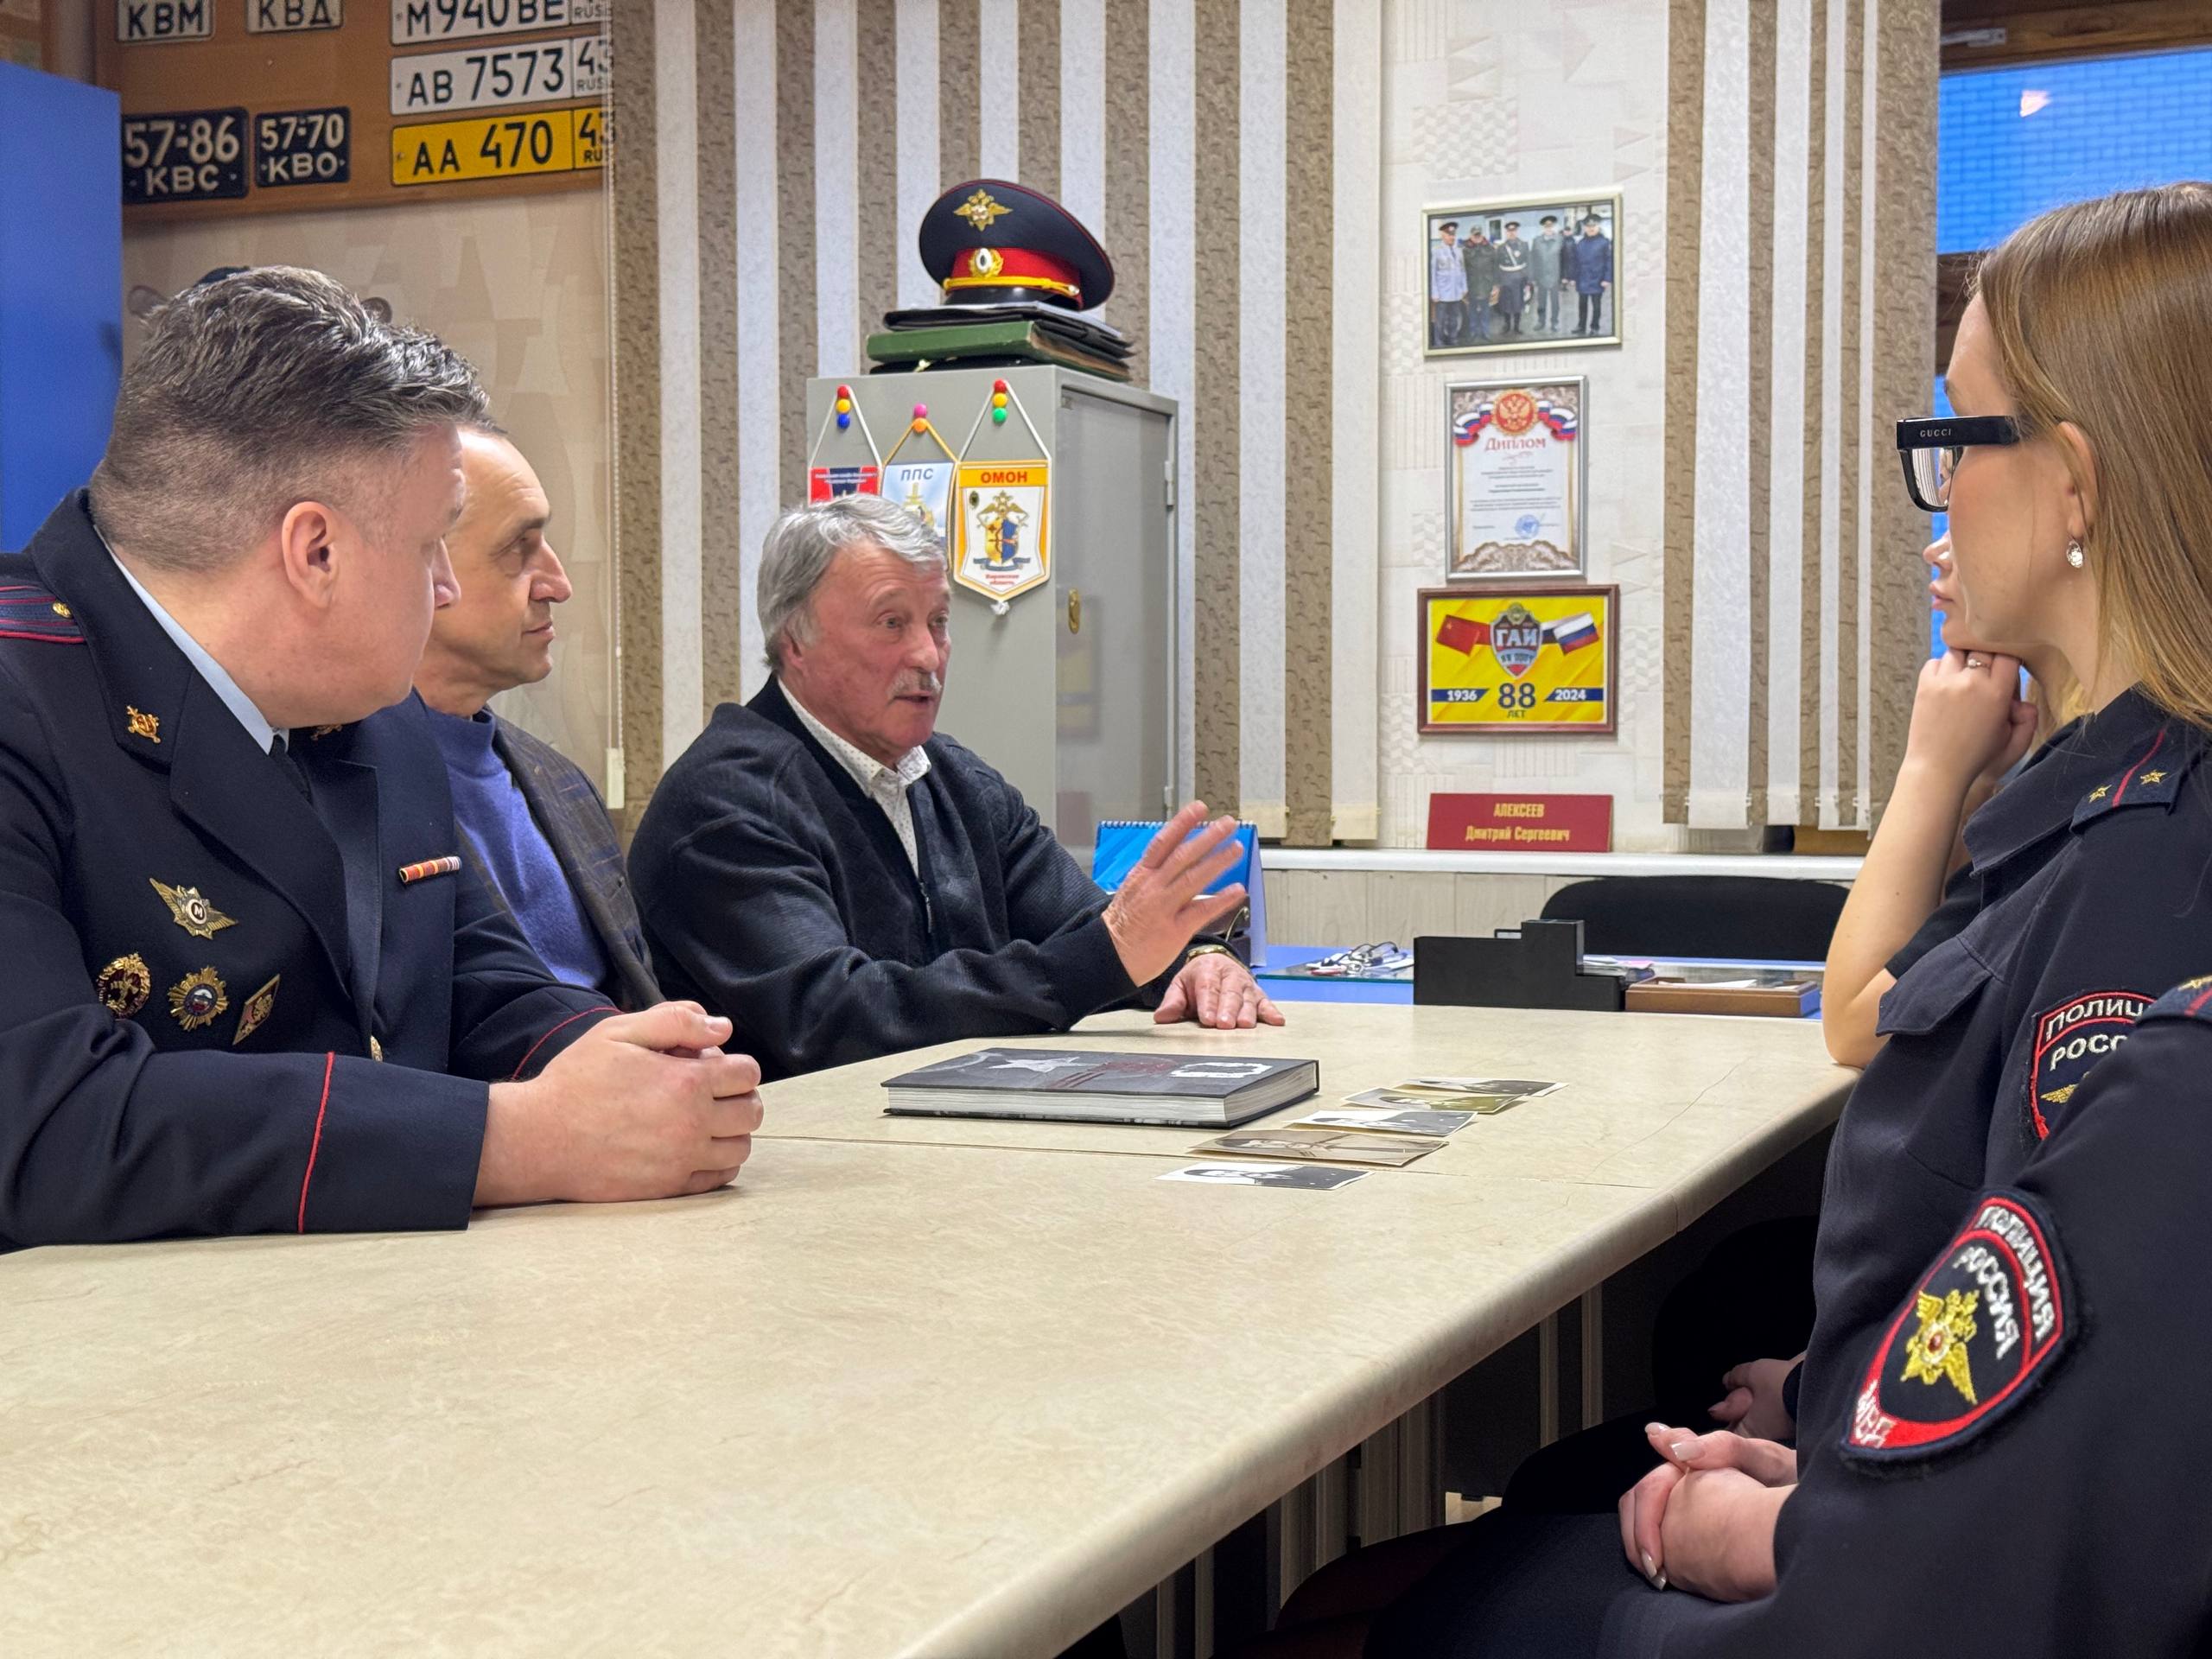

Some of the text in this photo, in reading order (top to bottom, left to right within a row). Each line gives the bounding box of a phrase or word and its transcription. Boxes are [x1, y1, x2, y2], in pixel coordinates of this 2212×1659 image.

[466, 48, 564, 100] 7573
[480, 120, 553, 168] 470
[1920, 429, 1951, 437] GUCCI
[1484, 437, 1547, 451] Диплом
[900, 467, 934, 481] ППС
[981, 471, 1028, 484] ОМОН
[1496, 628, 1537, 646] ГАИ
[1446, 690, 1478, 702] 1936
[1497, 683, 1536, 709] 88
[1554, 689, 1586, 701] 2024
[1493, 803, 1545, 817] АЛЕКСЕЕВ
[1465, 825, 1571, 842] Дмитрий Сергеевич
[2045, 998, 2145, 1042] ПОЛИЦ
[1974, 1206, 2055, 1341] ПОЛИЦИЯ
[1952, 1246, 2020, 1359] РОССИЯ
